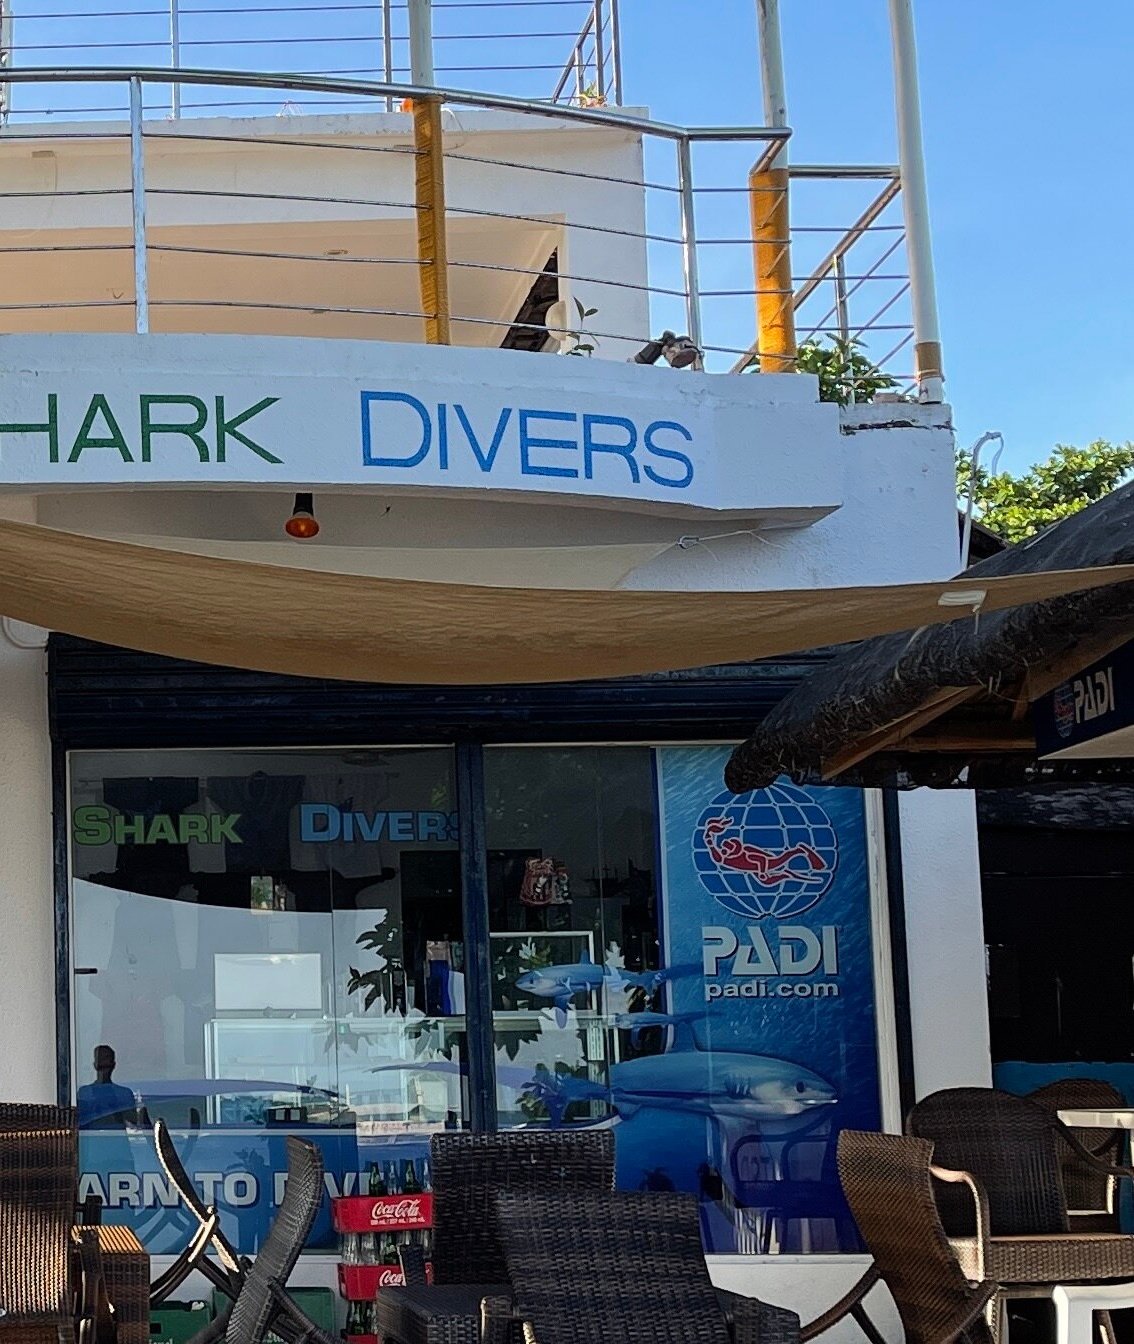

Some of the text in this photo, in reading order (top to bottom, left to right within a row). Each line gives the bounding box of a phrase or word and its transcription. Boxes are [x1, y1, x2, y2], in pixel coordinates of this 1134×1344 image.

[359, 389, 695, 488] DIVERS
[1073, 666, 1115, 724] PADI
[73, 804, 243, 846] SHARK
[702, 924, 840, 978] PADI
[704, 978, 840, 1002] padi.com
[194, 1171, 259, 1207] TO
[371, 1199, 422, 1220] Coca-Cola
